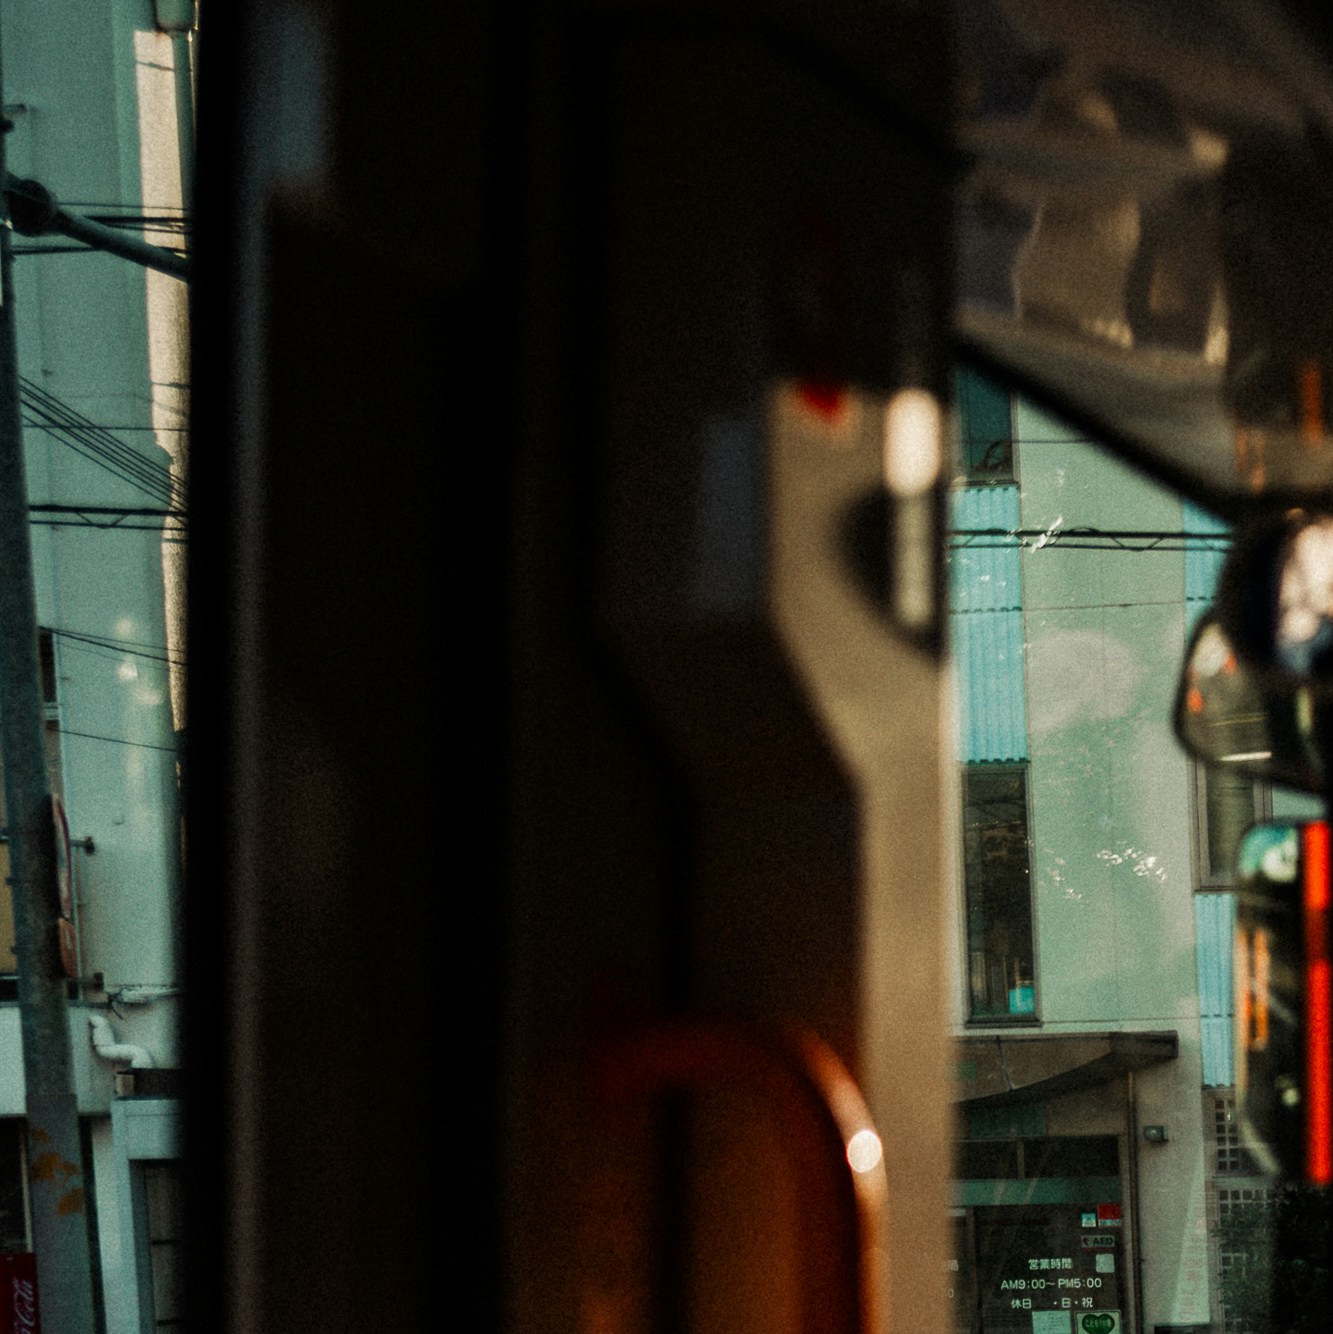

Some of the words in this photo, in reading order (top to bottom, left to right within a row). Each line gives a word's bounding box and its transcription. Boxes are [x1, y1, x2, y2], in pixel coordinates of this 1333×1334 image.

[1092, 1236, 1114, 1246] AED
[1028, 1257, 1073, 1271] 営業時間
[1011, 1298, 1032, 1309] 休日
